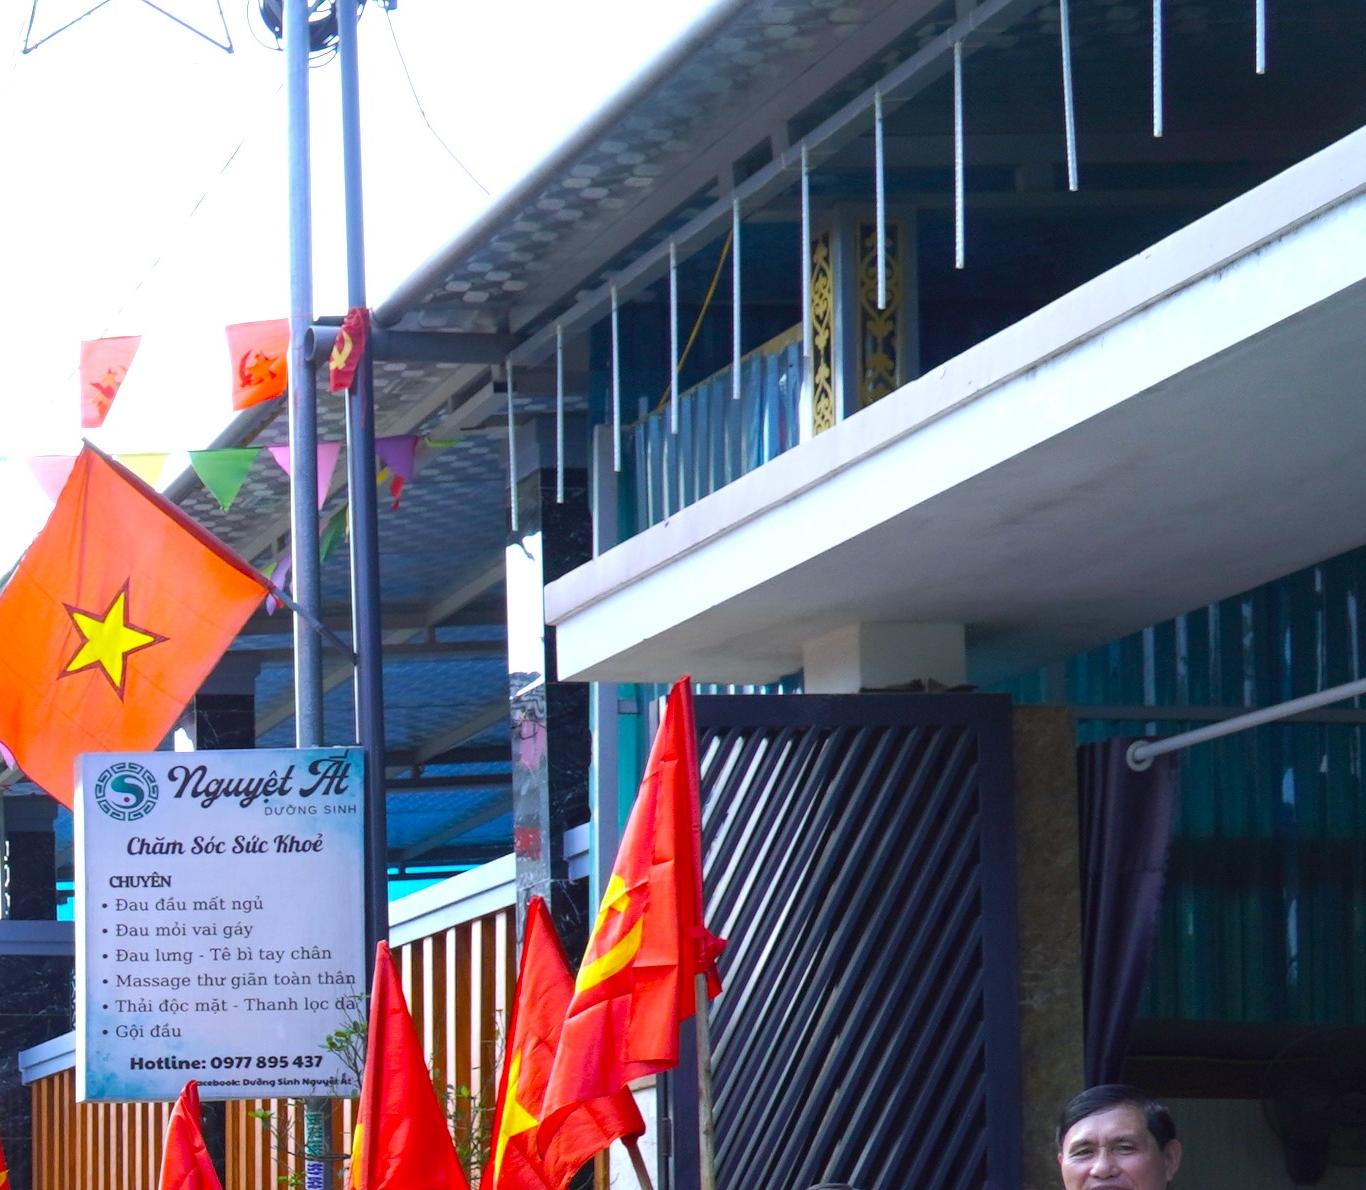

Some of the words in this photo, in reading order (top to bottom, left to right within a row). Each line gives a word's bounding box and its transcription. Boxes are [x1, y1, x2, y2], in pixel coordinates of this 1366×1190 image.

[168, 765, 295, 809] Nguyệt
[298, 749, 352, 797] Ất
[264, 803, 317, 816] DƯỠNG
[324, 804, 357, 814] SINH
[127, 836, 185, 855] Chăm
[191, 835, 225, 854] Sóc
[232, 834, 269, 854] Sức
[273, 832, 324, 854] Khoẻ
[109, 872, 172, 888] CHUYÊN
[115, 898, 149, 912] Đau
[155, 897, 187, 912] đầu
[192, 896, 227, 910] mất
[231, 895, 264, 913] ngủ
[115, 923, 149, 936] Đau
[155, 922, 186, 936] mỏi
[193, 922, 217, 936] vai
[223, 922, 253, 938] gáy
[115, 948, 149, 962] Đau
[155, 948, 193, 964] lưng
[209, 946, 231, 961] Tê
[237, 946, 253, 960] bì
[259, 948, 285, 964] tay
[291, 946, 332, 960] chân
[115, 974, 191, 990] Massage
[197, 974, 225, 987] thư
[231, 974, 268, 990] giãn
[274, 972, 311, 986] toàn
[318, 971, 356, 986] thân
[115, 998, 153, 1013] Thải
[158, 998, 189, 1014] độc
[195, 998, 229, 1014] mặt
[243, 998, 298, 1012] Thanh
[304, 996, 329, 1013] lọc
[335, 996, 356, 1010] da
[115, 1024, 143, 1040] Gội
[149, 1023, 181, 1038] đầu
[130, 1056, 207, 1071] Hotline:
[210, 1056, 252, 1070] 0977
[255, 1056, 289, 1069] 895
[292, 1055, 323, 1068] 437
[196, 1078, 241, 1087] acebook:
[243, 1077, 275, 1088] Dưỡng
[277, 1078, 299, 1086] Sinh
